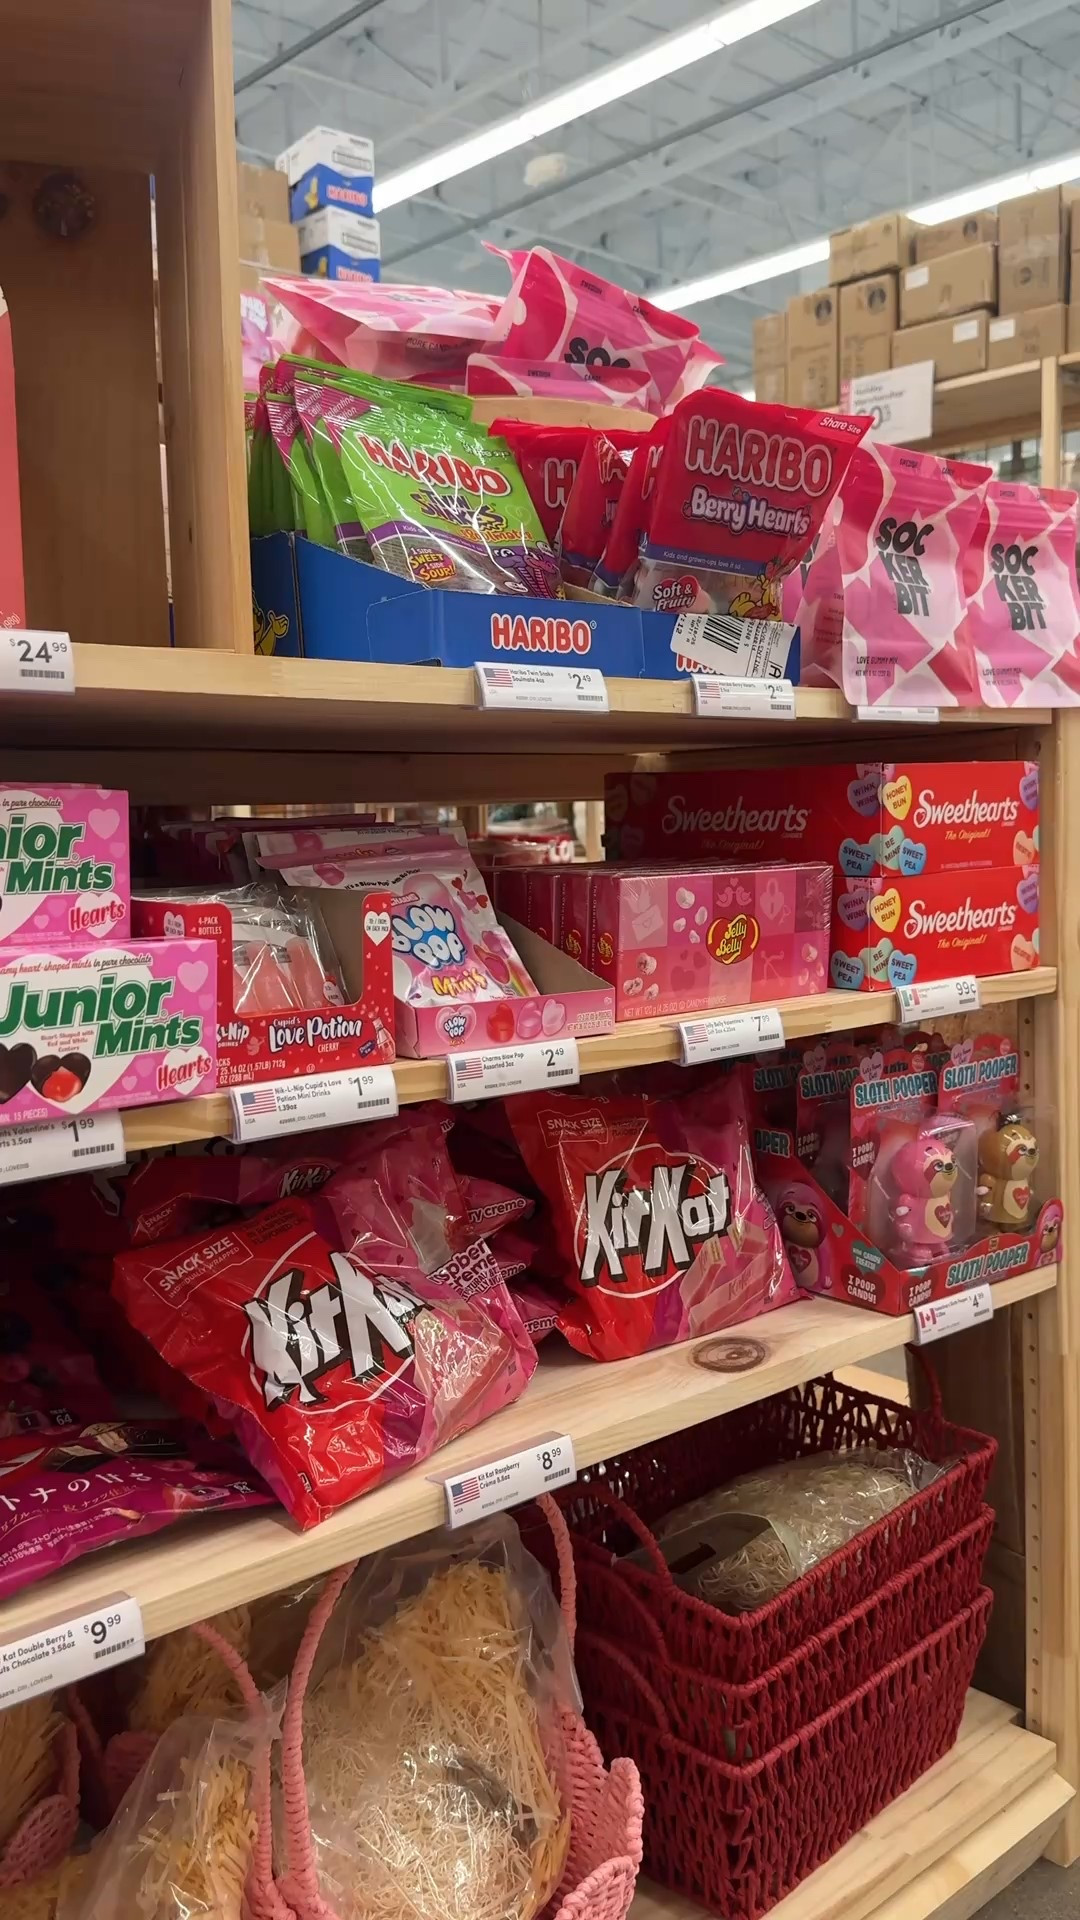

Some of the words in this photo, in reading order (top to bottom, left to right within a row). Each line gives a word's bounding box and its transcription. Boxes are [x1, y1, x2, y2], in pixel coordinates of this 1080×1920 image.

[820, 416, 847, 431] Share
[847, 423, 862, 435] Size
[354, 431, 512, 497] HARIBO
[685, 415, 832, 497] HARIBO
[691, 486, 746, 532] Berry
[749, 500, 812, 535] Hearts
[876, 518, 934, 555] SOC
[409, 553, 444, 570] SWEET
[663, 552, 676, 560] Kids
[688, 556, 717, 567] grown-ups
[718, 560, 729, 568] love
[991, 543, 1038, 576] SOC
[420, 565, 456, 581] SOUR!
[878, 551, 929, 586] KER
[653, 582, 683, 600] Soft
[684, 583, 693, 594] &
[994, 573, 1044, 603] KER
[655, 594, 696, 612] Fruity
[896, 581, 930, 617] BIT
[1011, 602, 1048, 631] BIT
[490, 613, 592, 655] HARIBO
[856, 656, 869, 665] LOVE
[853, 782, 876, 798] WINK
[886, 783, 908, 800] HONEY
[10, 800, 27, 809] pure
[28, 797, 62, 807] chocolate
[892, 797, 907, 810] BUN
[914, 789, 1019, 829] Sweethearts
[662, 795, 809, 834] Sweethearts
[884, 837, 896, 850] BE
[945, 829, 958, 840] The
[958, 828, 991, 844] Original!
[842, 846, 872, 862] SWEET
[902, 846, 924, 861] SWEET
[846, 859, 863, 872] PEA
[903, 859, 916, 871] PEA
[4, 856, 115, 895] Mints
[843, 896, 865, 912] WINK
[874, 896, 897, 914] HONEY
[69, 900, 126, 932] Hearts
[198, 916, 219, 926] 4-PACK
[880, 910, 896, 923] BUN
[903, 897, 1017, 939] Sweethearts
[198, 926, 223, 936] BOTTLES
[725, 918, 747, 940] Jelly
[411, 931, 466, 969] POP
[716, 938, 742, 958] Belly
[937, 937, 951, 949] The
[952, 934, 987, 950] Original!
[872, 949, 884, 962] BE
[891, 957, 914, 971] SWEET
[20, 961, 71, 975] heart-shaped
[71, 958, 93, 969] mints
[93, 959, 102, 968] in
[101, 959, 119, 971] pure
[119, 955, 153, 966] chocolate
[834, 958, 861, 975] SWEET
[431, 968, 488, 998] Minis
[837, 971, 853, 984] PEA
[893, 969, 907, 982] PEA
[0, 973, 175, 1038] Junior
[273, 1016, 301, 1028] Cupid's
[444, 1016, 466, 1032] BLOW
[449, 1024, 467, 1037] POP
[93, 1011, 203, 1059] Mints
[269, 1025, 305, 1053] Love
[307, 1015, 363, 1047] Potion
[317, 1042, 340, 1053] CHERRY
[481, 1055, 501, 1063] Charms
[502, 1053, 514, 1061] Blow
[514, 1052, 524, 1060] Pop
[483, 1061, 505, 1071] Assorted
[157, 1055, 212, 1090] Hearts
[220, 1066, 237, 1076] 25.14
[238, 1064, 247, 1073] OZ
[272, 1060, 286, 1069] 712g
[943, 1062, 977, 1091] SLOTH
[978, 1053, 1018, 1084] POOPER
[220, 1075, 228, 1084] OZ
[275, 1083, 304, 1094] Nik-L-Nip
[305, 1080, 327, 1091] Cupid's
[328, 1079, 342, 1087] Love
[800, 1071, 837, 1099] SLOTH
[276, 1094, 297, 1103] Potion
[297, 1092, 311, 1100] Mini
[311, 1089, 331, 1098] Drinks
[855, 1079, 891, 1108] SLOTH
[893, 1071, 938, 1100] POOPER
[22, 1107, 49, 1119] PIECES)
[278, 1104, 298, 1113] 1.39oz
[12, 1123, 55, 1135] Valentine's
[547, 1119, 580, 1130] SNACK
[580, 1117, 603, 1128] SIZE
[12, 1137, 33, 1147] 3.5oz
[857, 1142, 874, 1155] POOP
[852, 1151, 876, 1168] CANDY!
[144, 1206, 174, 1228] SNACK
[484, 1199, 526, 1218] creme
[159, 1253, 201, 1292] SNACK
[204, 1236, 235, 1262] SIZE
[207, 1246, 241, 1271] WRAPPED
[946, 1255, 983, 1289] SLOTH
[985, 1241, 1031, 1275] POOPER
[855, 1277, 876, 1291] POOP
[914, 1279, 932, 1295] POOP
[847, 1285, 877, 1305] CANDY!
[908, 1289, 932, 1308] CANDY!
[485, 1470, 495, 1479] Kat
[495, 1461, 520, 1475] Raspberry
[2, 1652, 17, 1662] Kat
[17, 1641, 45, 1657] Double
[45, 1635, 67, 1647] Berry
[67, 1629, 74, 1638] &
[11, 1651, 50, 1670] Chocolate
[51, 1640, 76, 1655] 3.58oz
